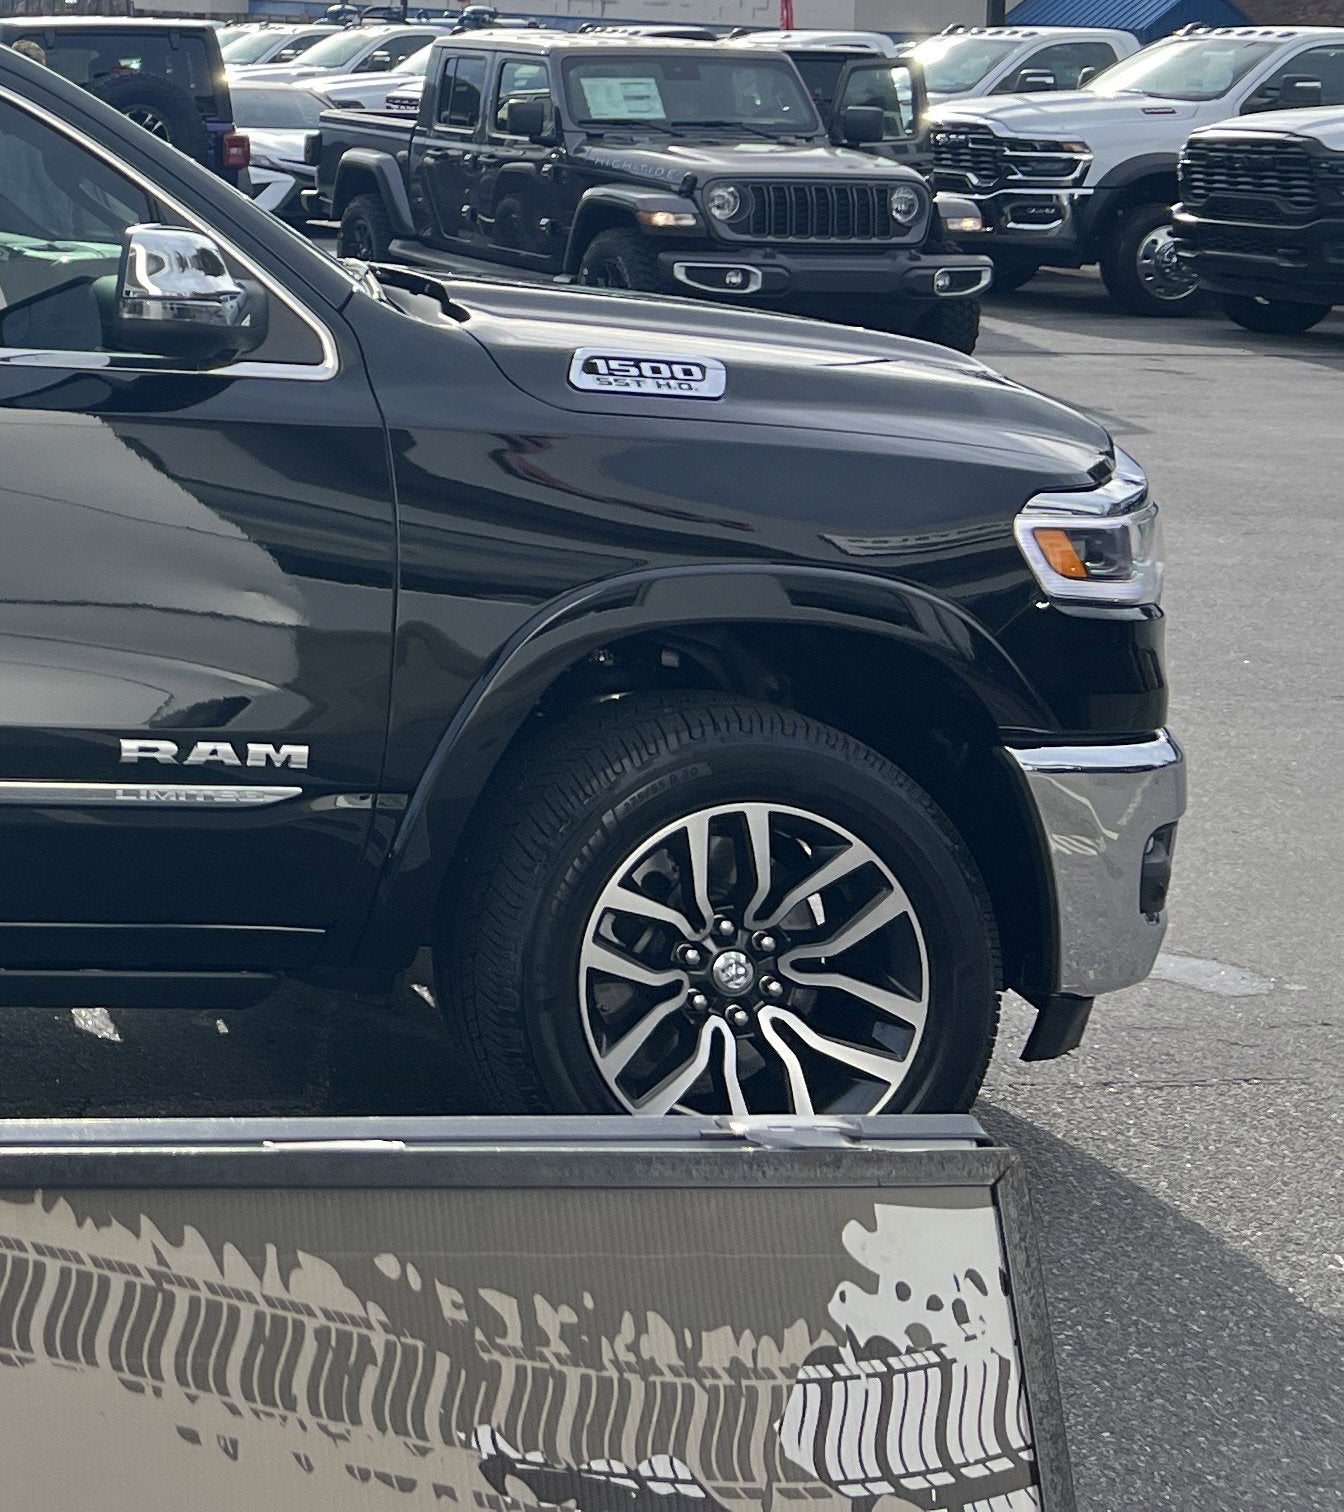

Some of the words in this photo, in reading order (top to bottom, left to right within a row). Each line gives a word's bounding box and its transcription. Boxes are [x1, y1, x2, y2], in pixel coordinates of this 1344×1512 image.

[587, 358, 705, 380] 1500
[595, 377, 646, 388] SST
[119, 738, 310, 769] RAM
